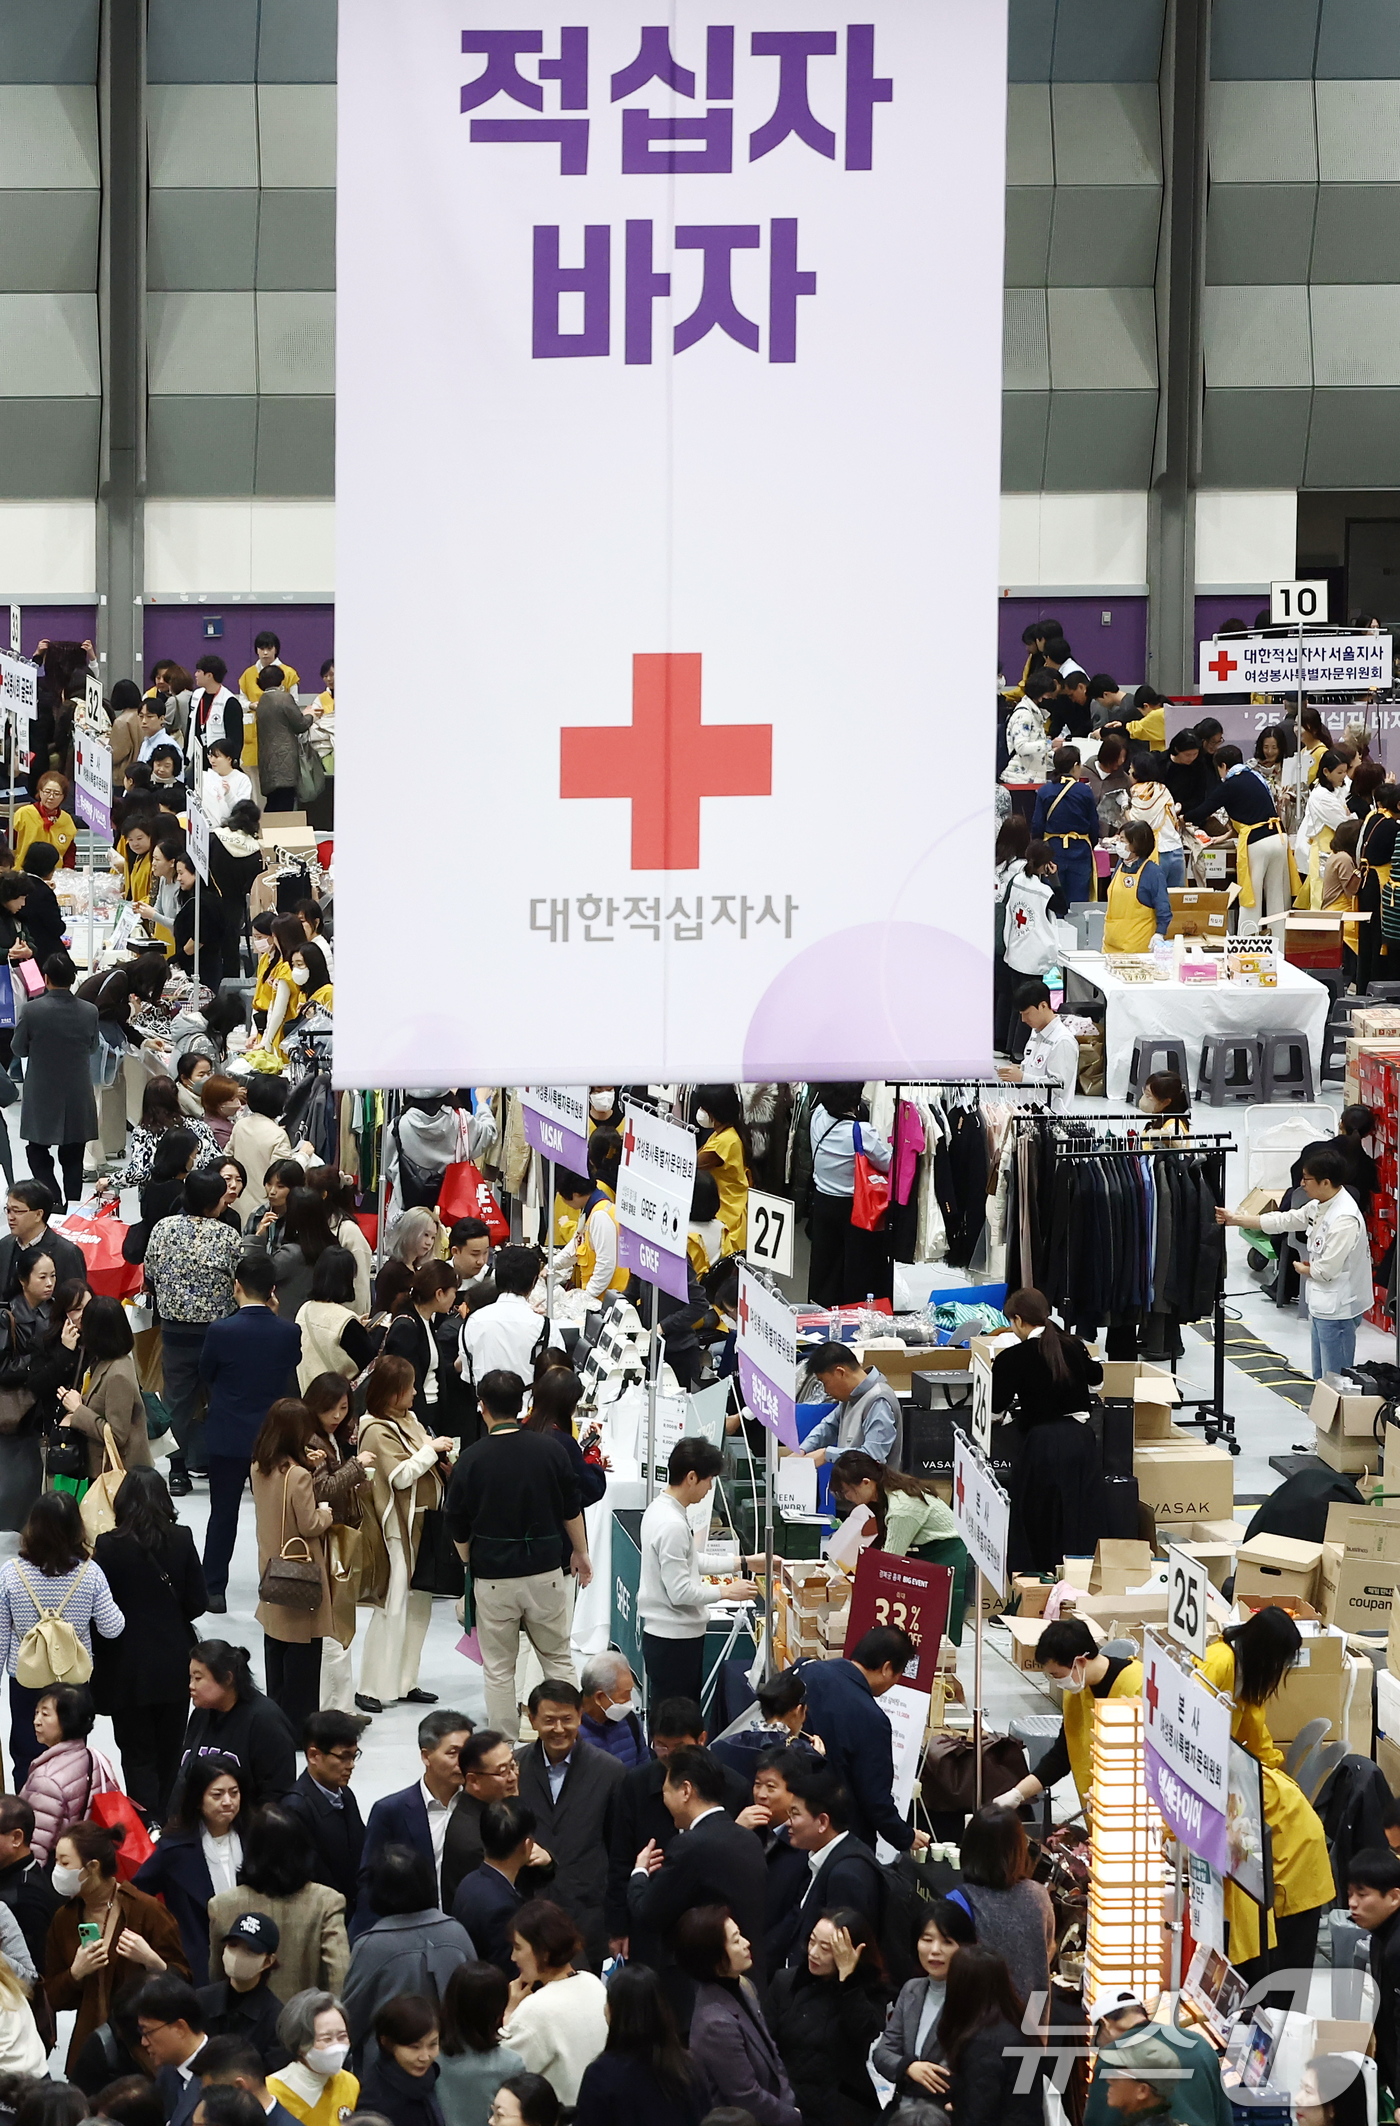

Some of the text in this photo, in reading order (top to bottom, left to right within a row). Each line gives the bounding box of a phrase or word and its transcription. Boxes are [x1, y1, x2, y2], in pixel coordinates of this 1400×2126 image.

[460, 24, 893, 175] 적십자
[532, 217, 817, 364] 바자
[1280, 588, 1317, 616] 10
[1244, 645, 1384, 664] 대한적십자사 서울지사
[1244, 666, 1383, 683] 여성봉사특별자문위원회
[88, 686, 99, 722] 32
[530, 893, 799, 942] 대한적십자사
[539, 1120, 564, 1153] VASAK
[641, 1198, 657, 1222] GREF
[754, 1206, 785, 1259] 27
[639, 1243, 660, 1274] GREF
[751, 1372, 780, 1427] 한국민속촌
[975, 1374, 987, 1436] 26
[902, 1575, 912, 1584] BIG
[911, 1577, 929, 1588] EVENT
[1173, 1567, 1198, 1637] 25
[1349, 1597, 1393, 1612] coupan
[1157, 1765, 1203, 1840] 넥센타이어
